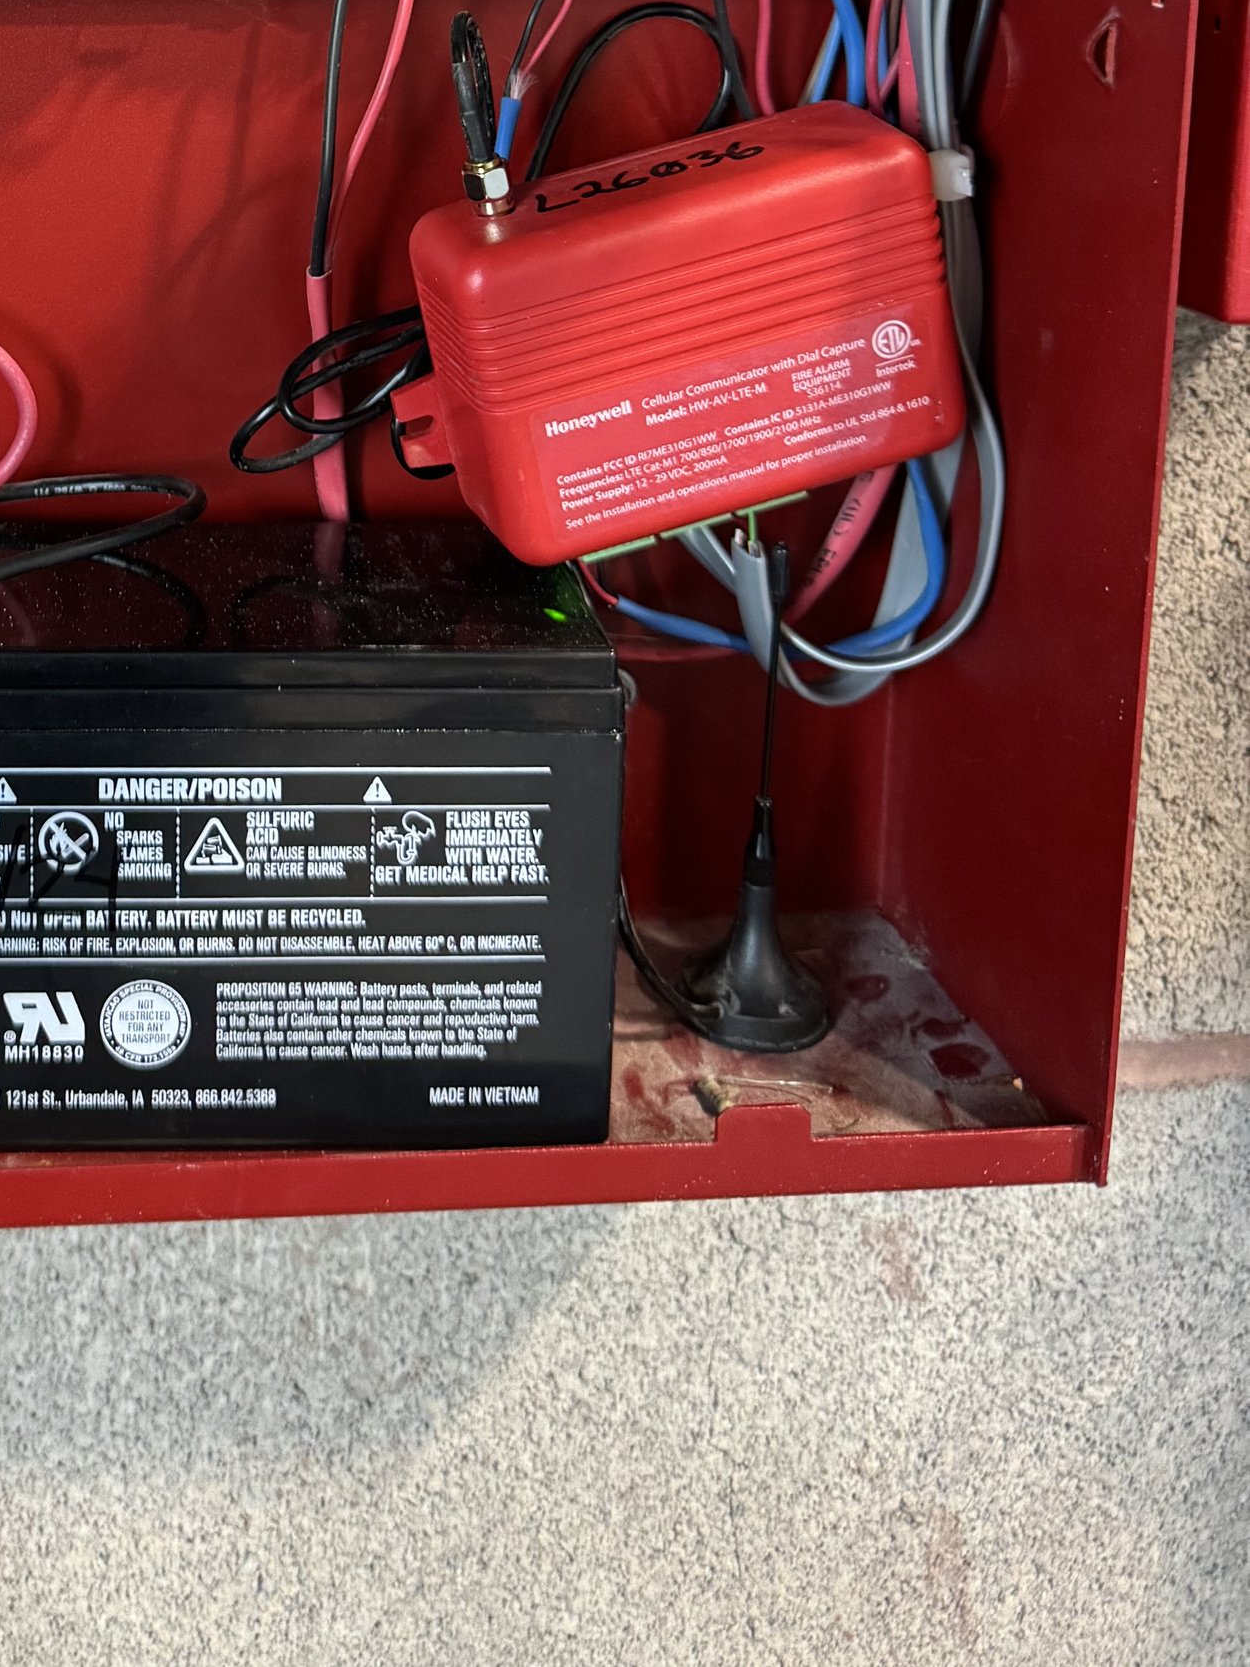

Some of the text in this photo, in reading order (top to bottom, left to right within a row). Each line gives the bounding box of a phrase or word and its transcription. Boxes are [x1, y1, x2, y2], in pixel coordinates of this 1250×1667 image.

[642, 337, 867, 410] Cellular Communicator with Dial Capture
[791, 358, 851, 383] FIRE ALARM
[875, 360, 917, 378] Intertek
[792, 367, 852, 392] EQUIPMENT
[646, 382, 767, 427] Model: HW-AV-LTE-M
[544, 399, 633, 437] Honeywell
[98, 776, 282, 802] DANGER/POISON
[104, 811, 125, 830] NO
[246, 811, 315, 830] SULFURIC
[446, 811, 531, 830] FLUSH EYES
[116, 829, 163, 846] SPARKS
[246, 828, 280, 845] ACID
[445, 828, 543, 848] IMMEDIATELY
[245, 846, 367, 862] CAN CAUSE BLINDNESS
[445, 847, 540, 865] WITH WATER.
[117, 862, 173, 879] SMOKING
[245, 862, 347, 878] OR SEVERE BURNS.
[375, 866, 550, 885] GET MEDICAL HELP FAST.
[429, 1087, 539, 1105] MADE IN VIETNAM
